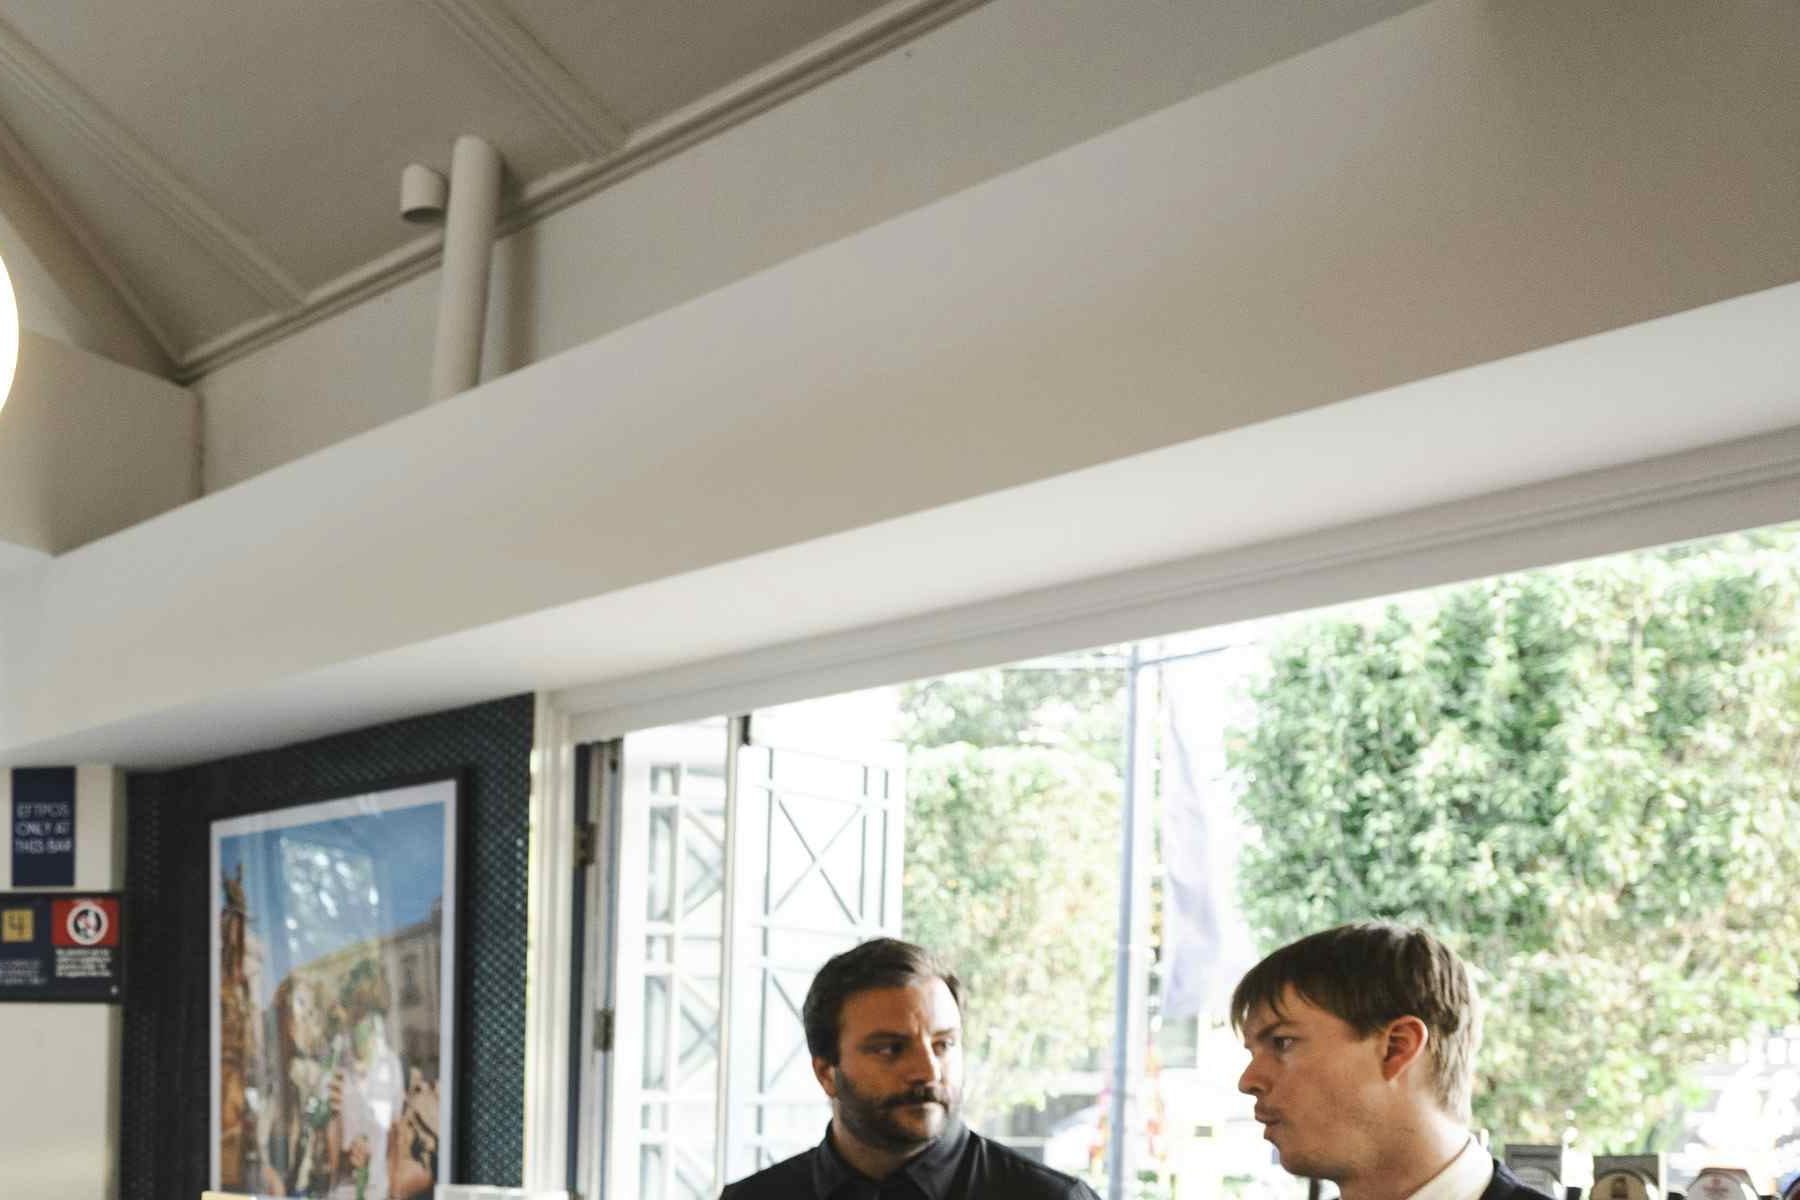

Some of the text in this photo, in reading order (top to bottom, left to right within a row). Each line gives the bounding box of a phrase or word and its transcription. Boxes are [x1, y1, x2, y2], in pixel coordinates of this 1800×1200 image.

[15, 820, 72, 836] ONLY AT
[15, 838, 44, 854] THIS
